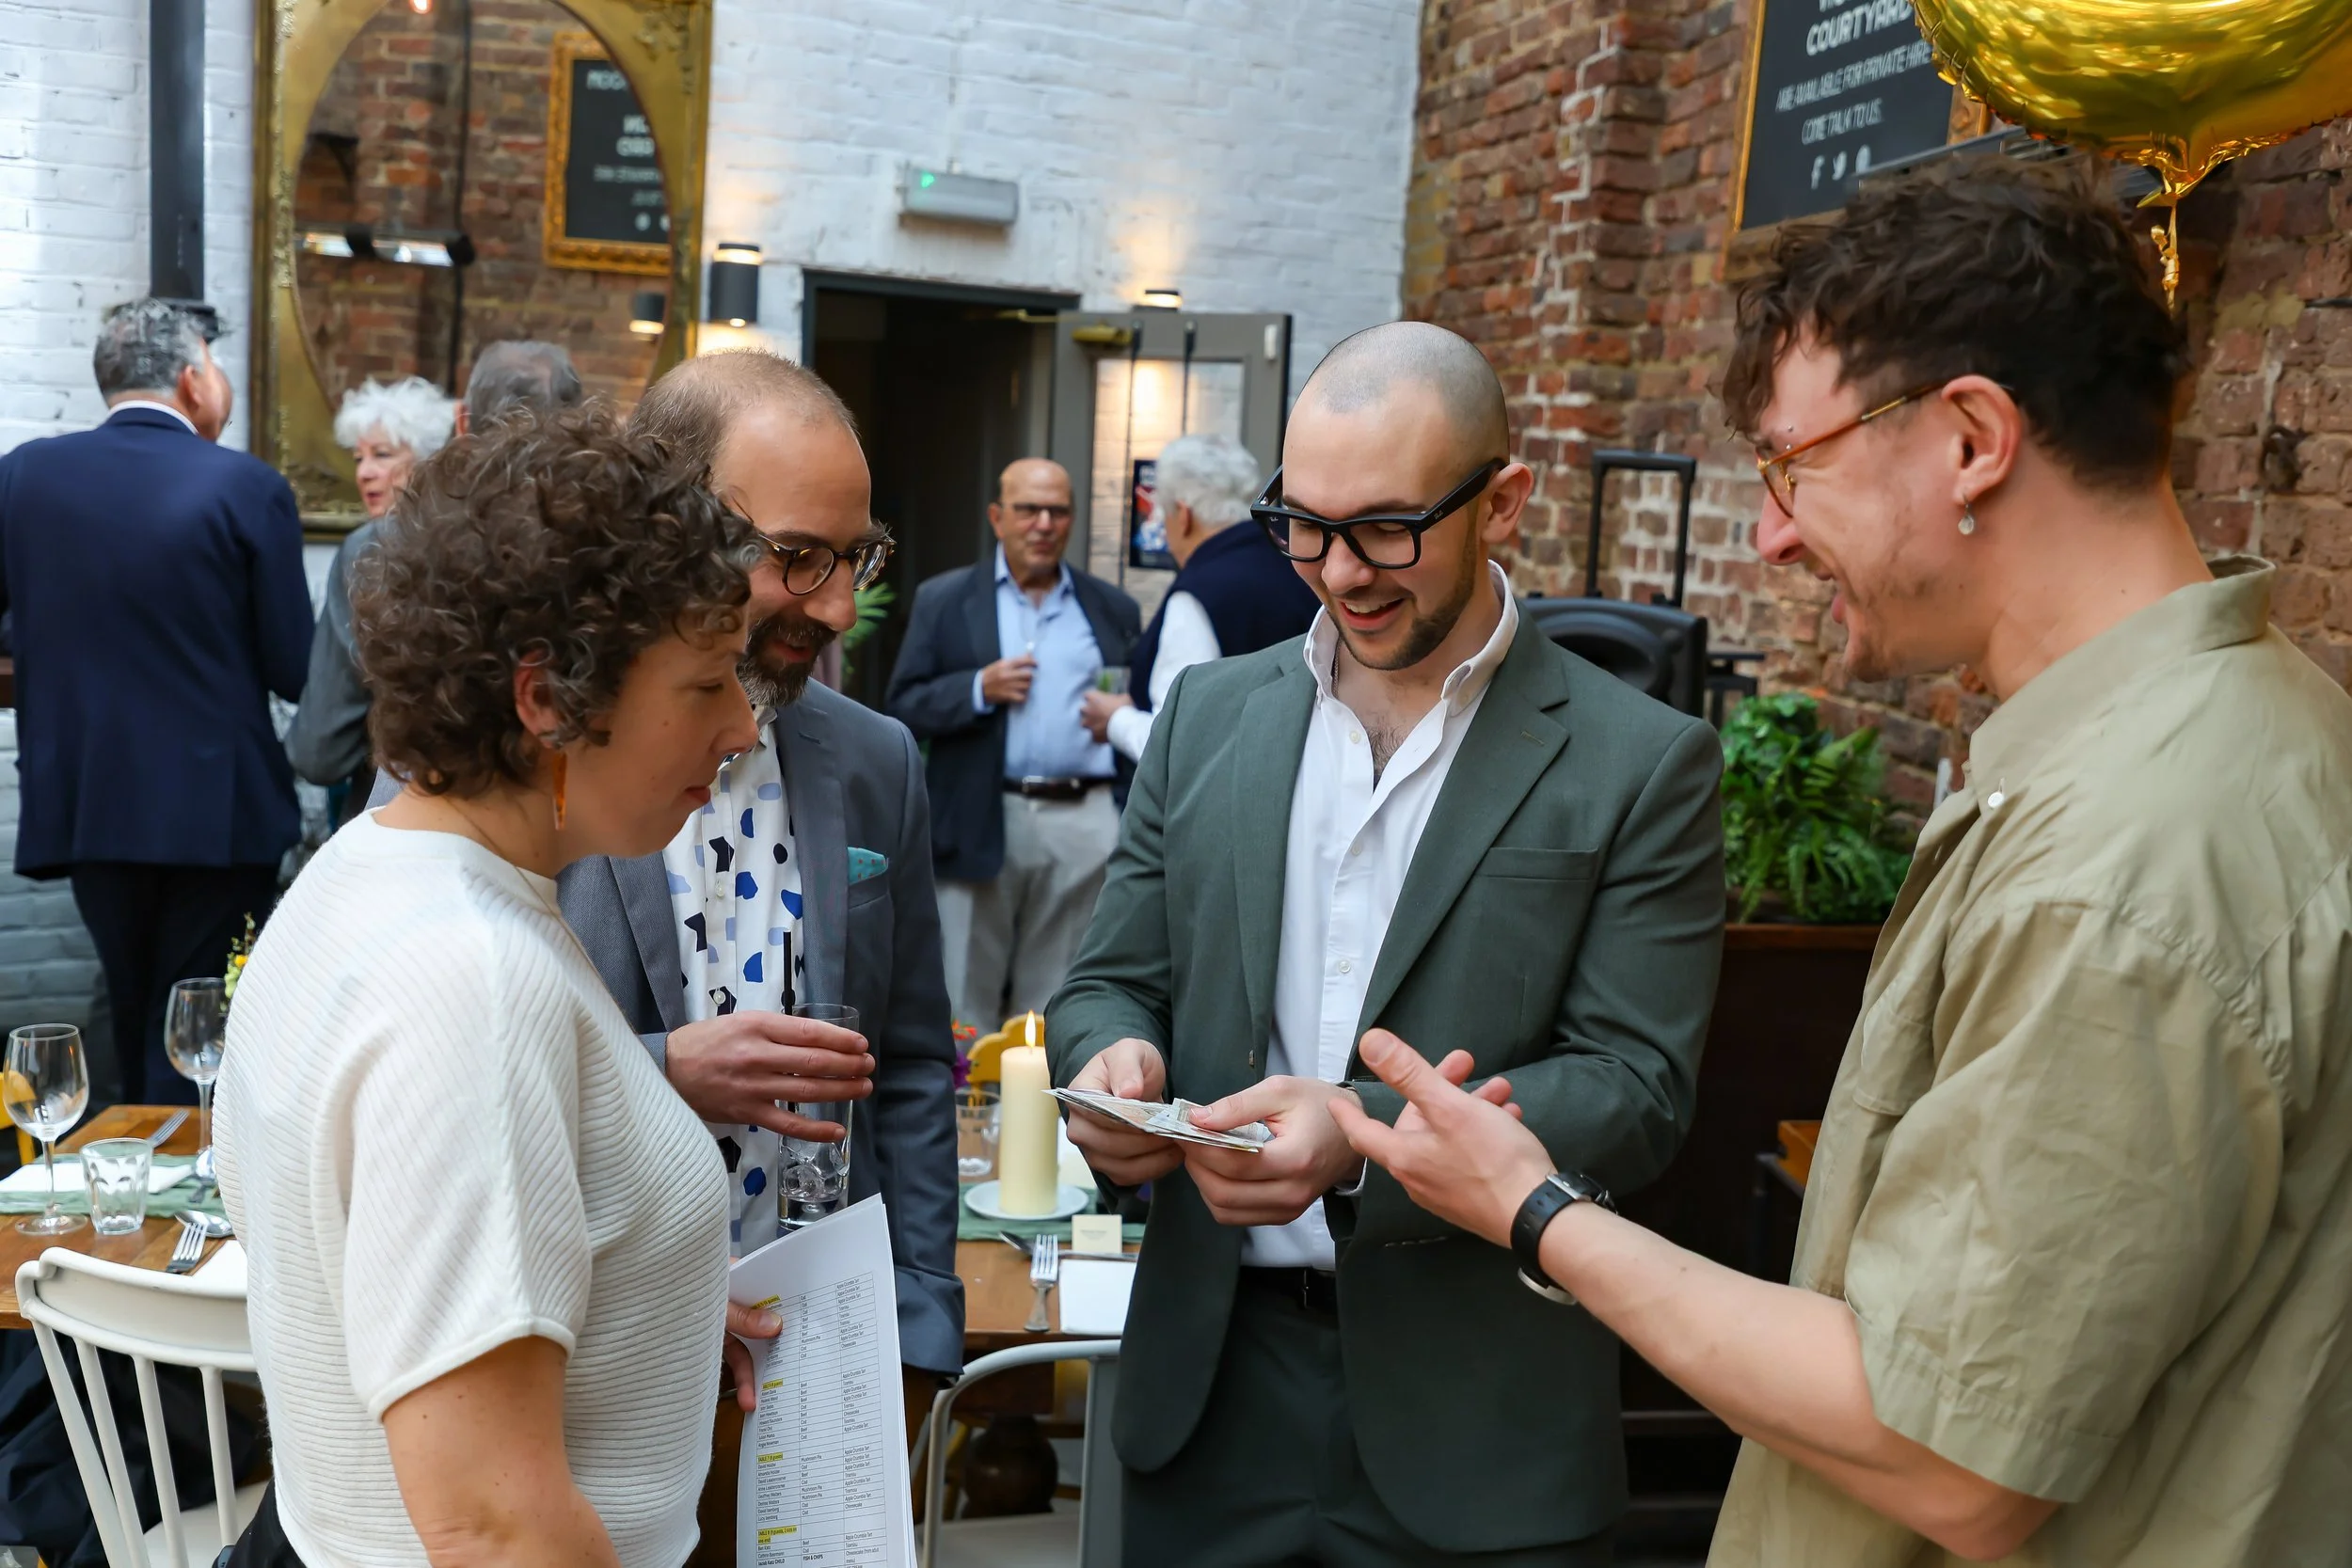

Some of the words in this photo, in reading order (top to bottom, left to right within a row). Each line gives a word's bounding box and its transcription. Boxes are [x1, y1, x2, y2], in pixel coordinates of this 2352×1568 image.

[1806, 0, 1913, 56] COURTYARD
[1775, 85, 1794, 113] ARE
[1794, 68, 1842, 106] AVAILABLE
[1842, 61, 1864, 89] FOR
[1863, 45, 1906, 86] PRIVATE
[1802, 114, 1827, 145] COME
[1827, 105, 1852, 137] TALK
[1851, 103, 1867, 130] TO
